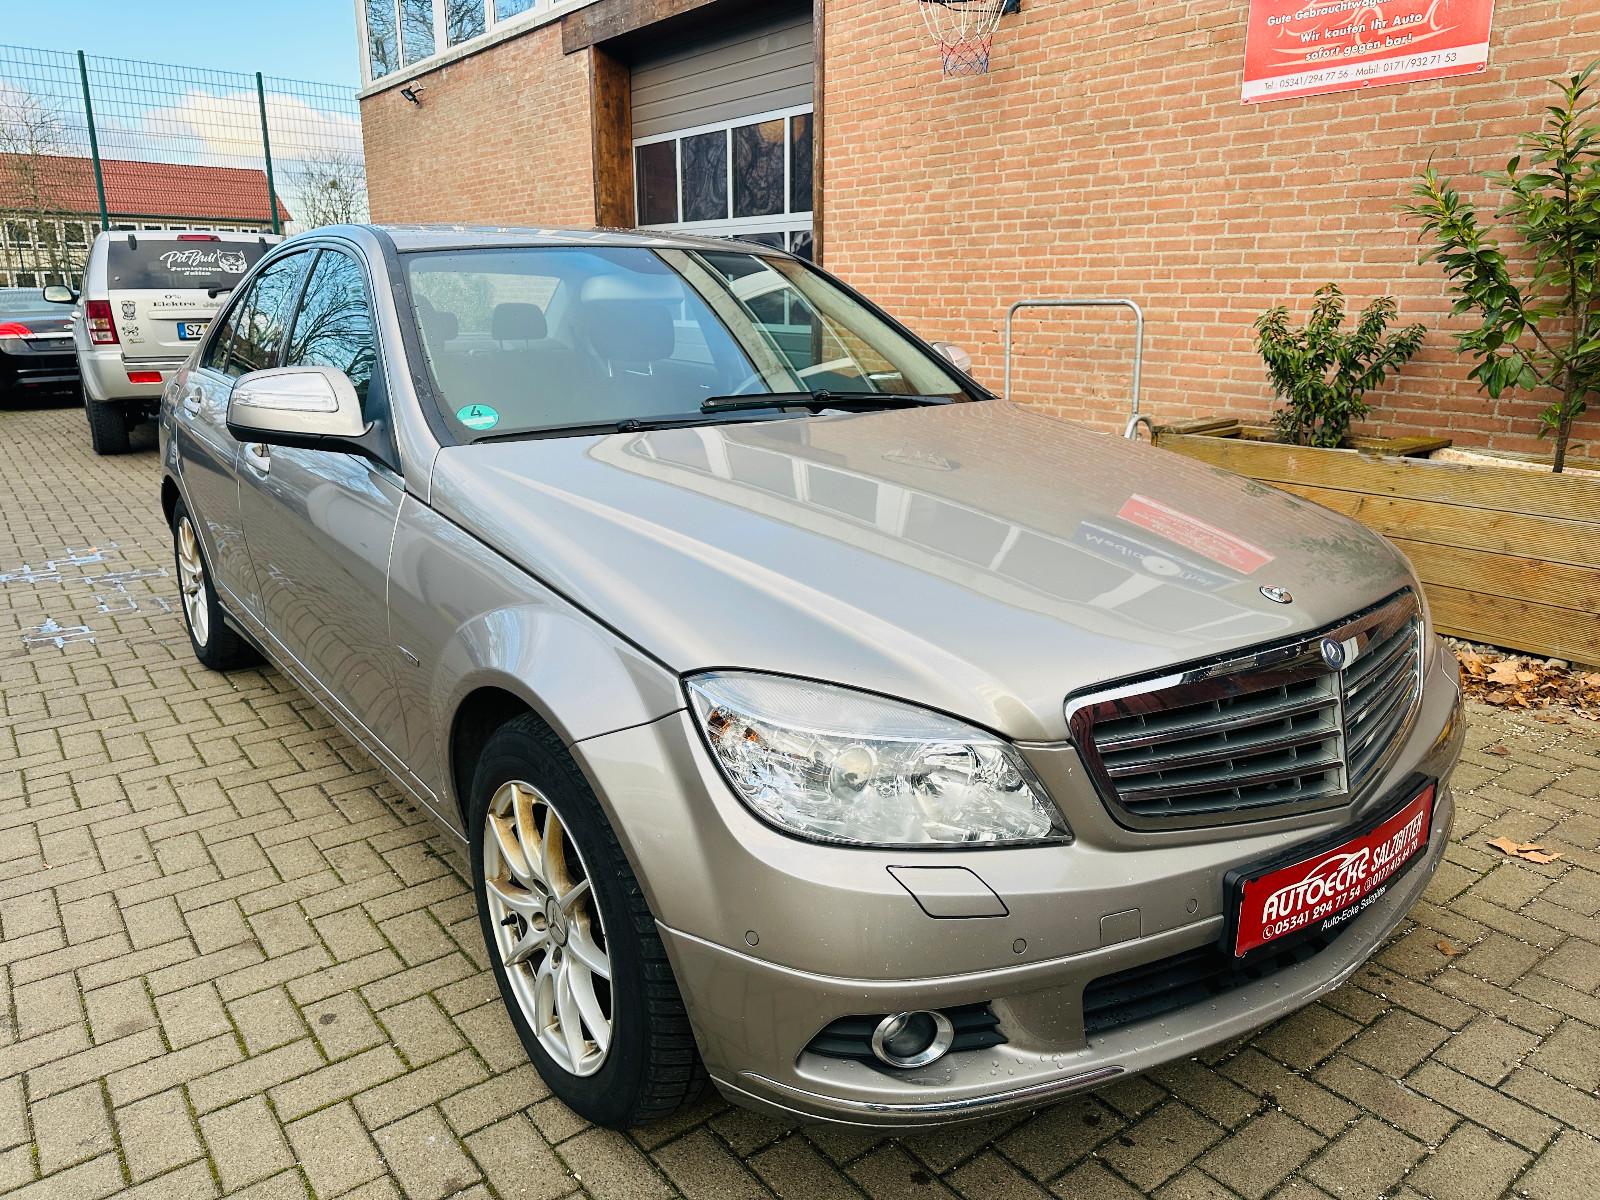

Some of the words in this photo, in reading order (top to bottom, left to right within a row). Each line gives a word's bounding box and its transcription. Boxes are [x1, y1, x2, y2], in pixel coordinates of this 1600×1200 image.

[1266, 14, 1292, 26] Gute
[1294, 0, 1392, 21] Gebrauchtwag
[1300, 31, 1321, 43] Wir
[1324, 24, 1367, 39] kaufen
[1370, 18, 1388, 30] Ihr
[1392, 13, 1424, 26] Auto
[1305, 47, 1341, 61] sofort
[1344, 40, 1382, 57] gegen
[1385, 32, 1413, 47] bar!
[1279, 73, 1323, 89] 05341/294
[1323, 71, 1336, 82] 77
[1355, 63, 1380, 77] Mobil:
[1383, 57, 1429, 73] 0171/932
[1430, 54, 1441, 65] 71
[1444, 52, 1457, 63] 53
[186, 324, 204, 336] SZ
[470, 405, 482, 417] 4
[1262, 847, 1369, 924] AUTOECKE
[1371, 810, 1424, 872] SALZGITTER
[1274, 910, 1310, 935] 05341
[1312, 899, 1333, 920] 294
[1335, 892, 1348, 909] 77
[1349, 884, 1361, 901] 54
[1321, 904, 1360, 932] Auto-Ecke
